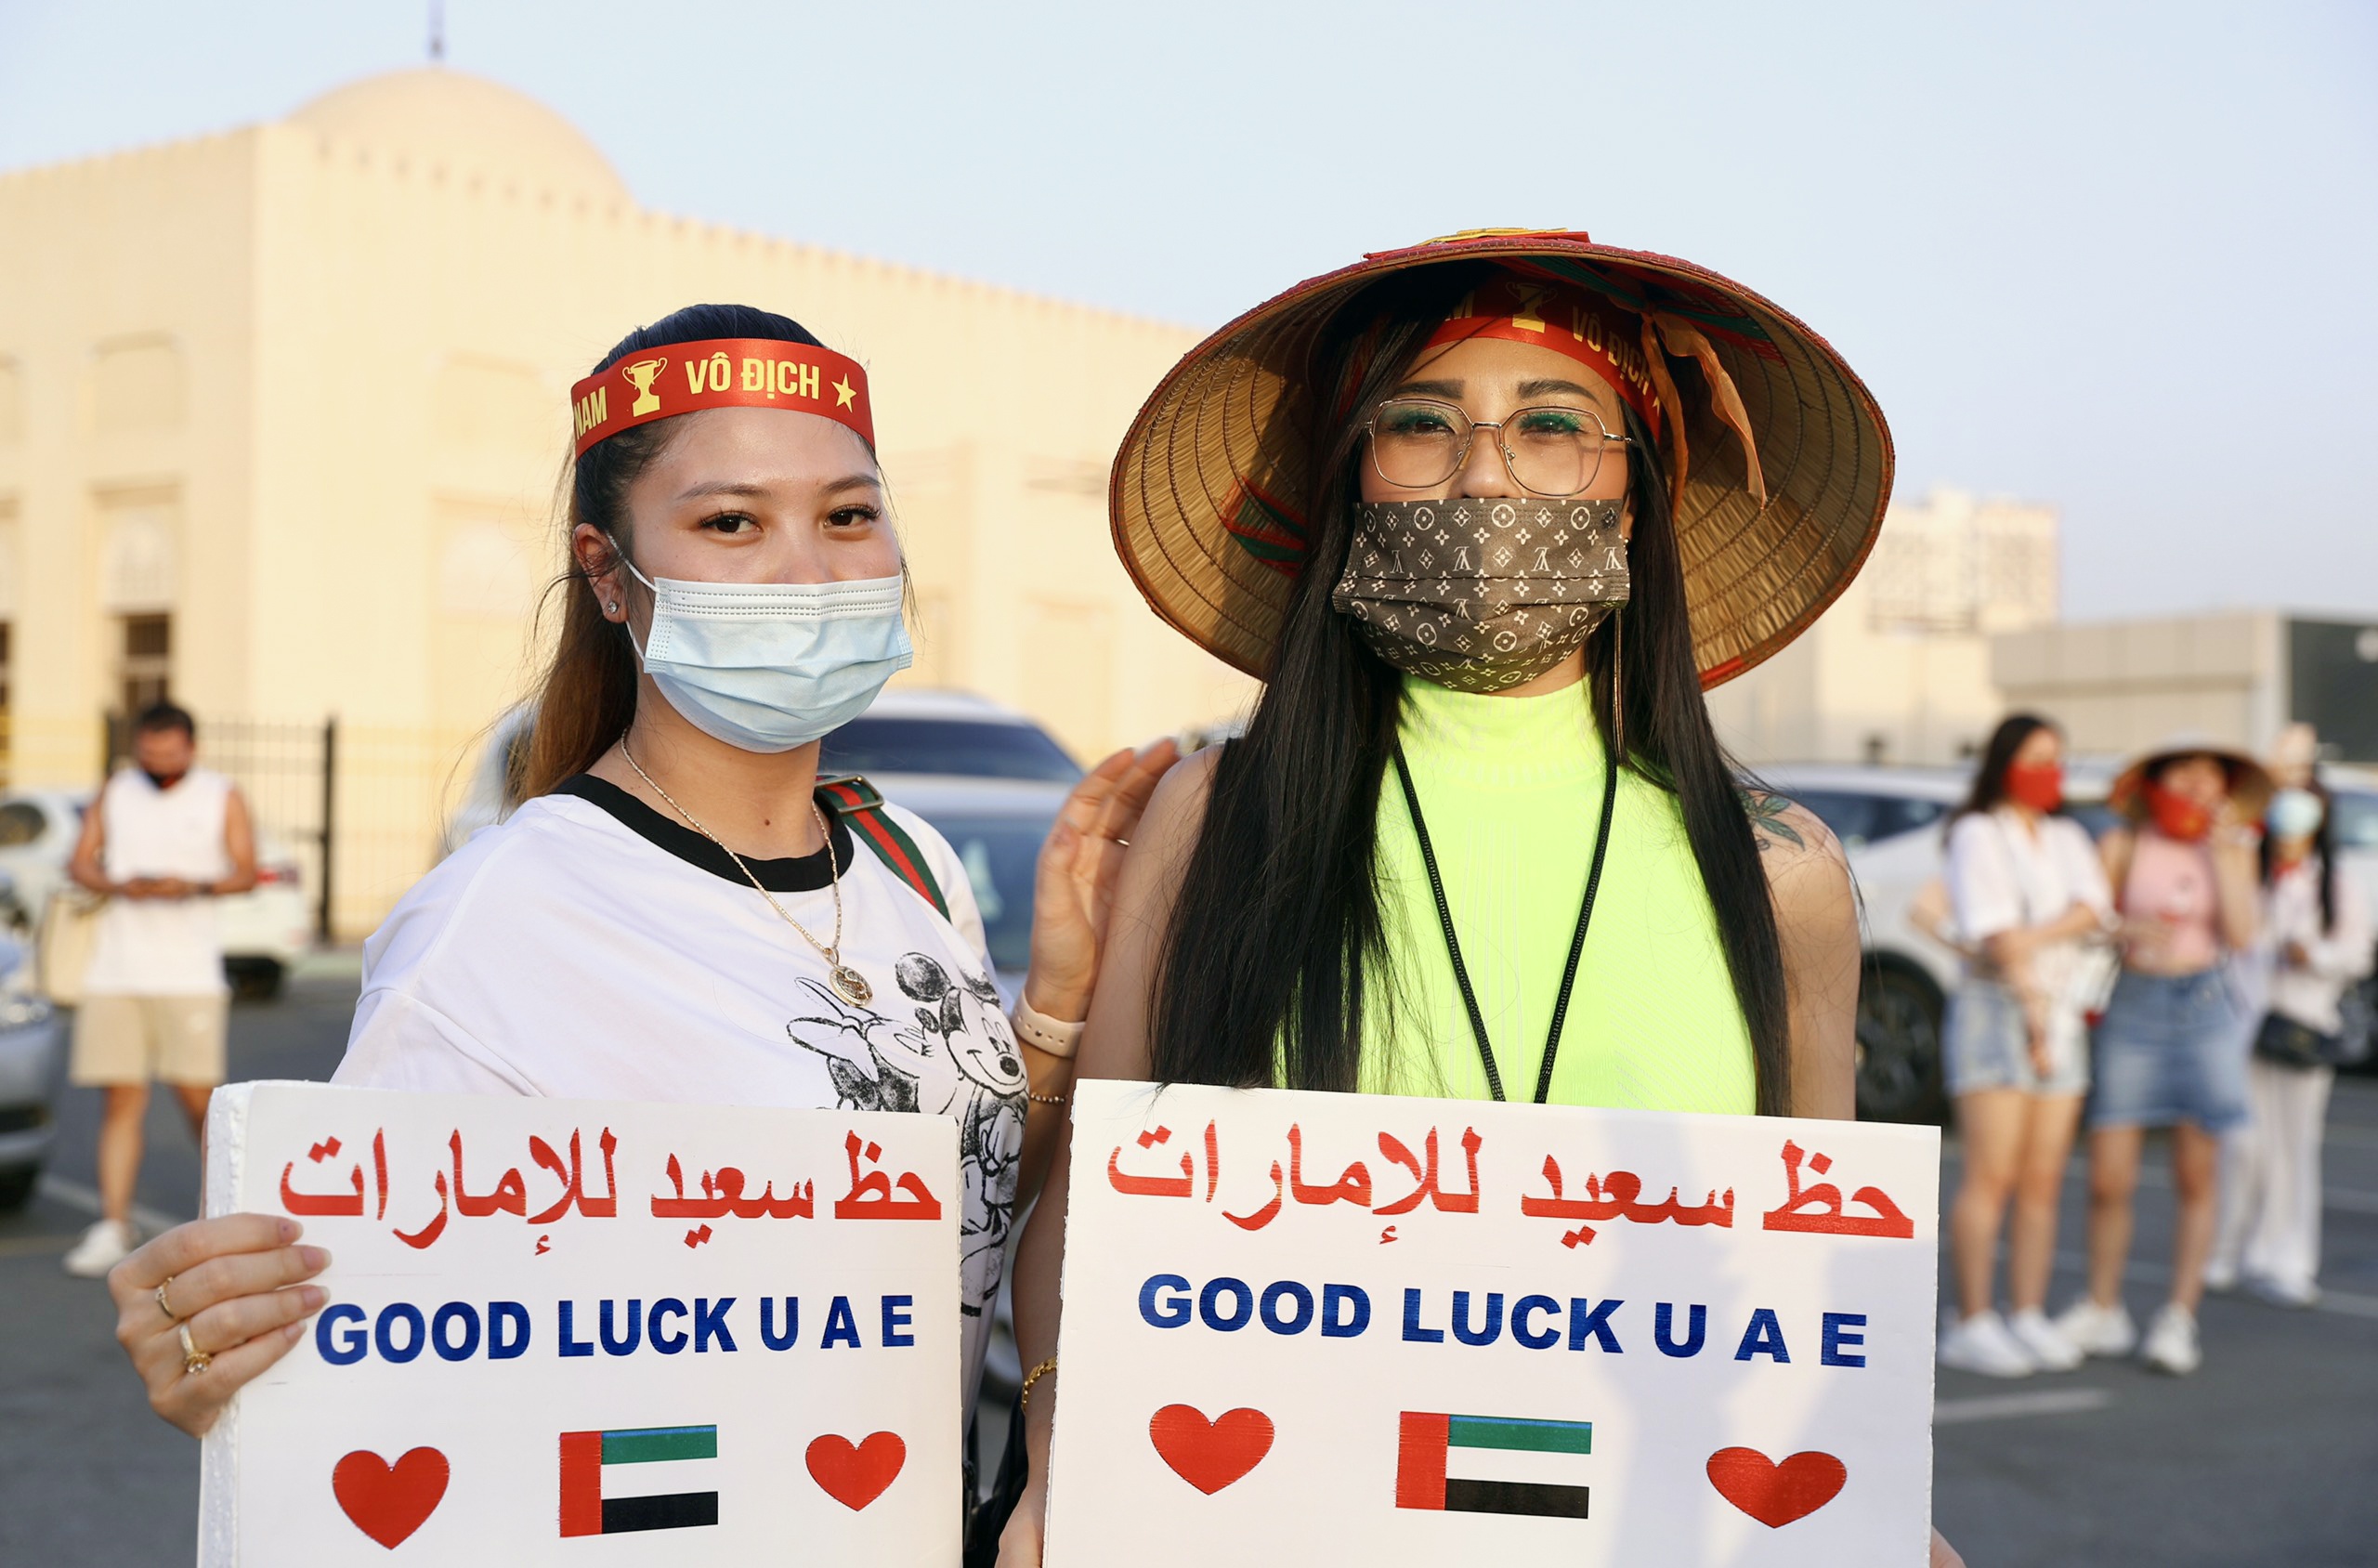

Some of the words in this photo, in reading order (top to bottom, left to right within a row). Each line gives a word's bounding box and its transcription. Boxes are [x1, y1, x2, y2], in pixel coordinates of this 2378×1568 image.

[1444, 290, 1475, 320] M
[1572, 305, 1601, 354] VÔ
[574, 385, 608, 440] NAM
[686, 352, 731, 395] VÔ
[740, 357, 820, 400] ĐỊCH
[281, 1128, 618, 1255] للإمارات
[652, 1154, 814, 1249] سعيد
[835, 1130, 942, 1221] حظ
[1107, 1119, 1482, 1244] للإمارات
[1522, 1155, 1734, 1249] سعيد
[1763, 1140, 1914, 1238] حظ
[317, 1302, 530, 1365] GOOD
[559, 1298, 738, 1357] LUCK
[762, 1297, 799, 1352] U
[821, 1297, 862, 1350] A
[882, 1296, 914, 1348] E
[1139, 1274, 1371, 1338] GOOD
[1403, 1288, 1624, 1353] LUCK
[1654, 1302, 1707, 1358] U
[1734, 1309, 1791, 1364] A
[1821, 1313, 1867, 1368] E
